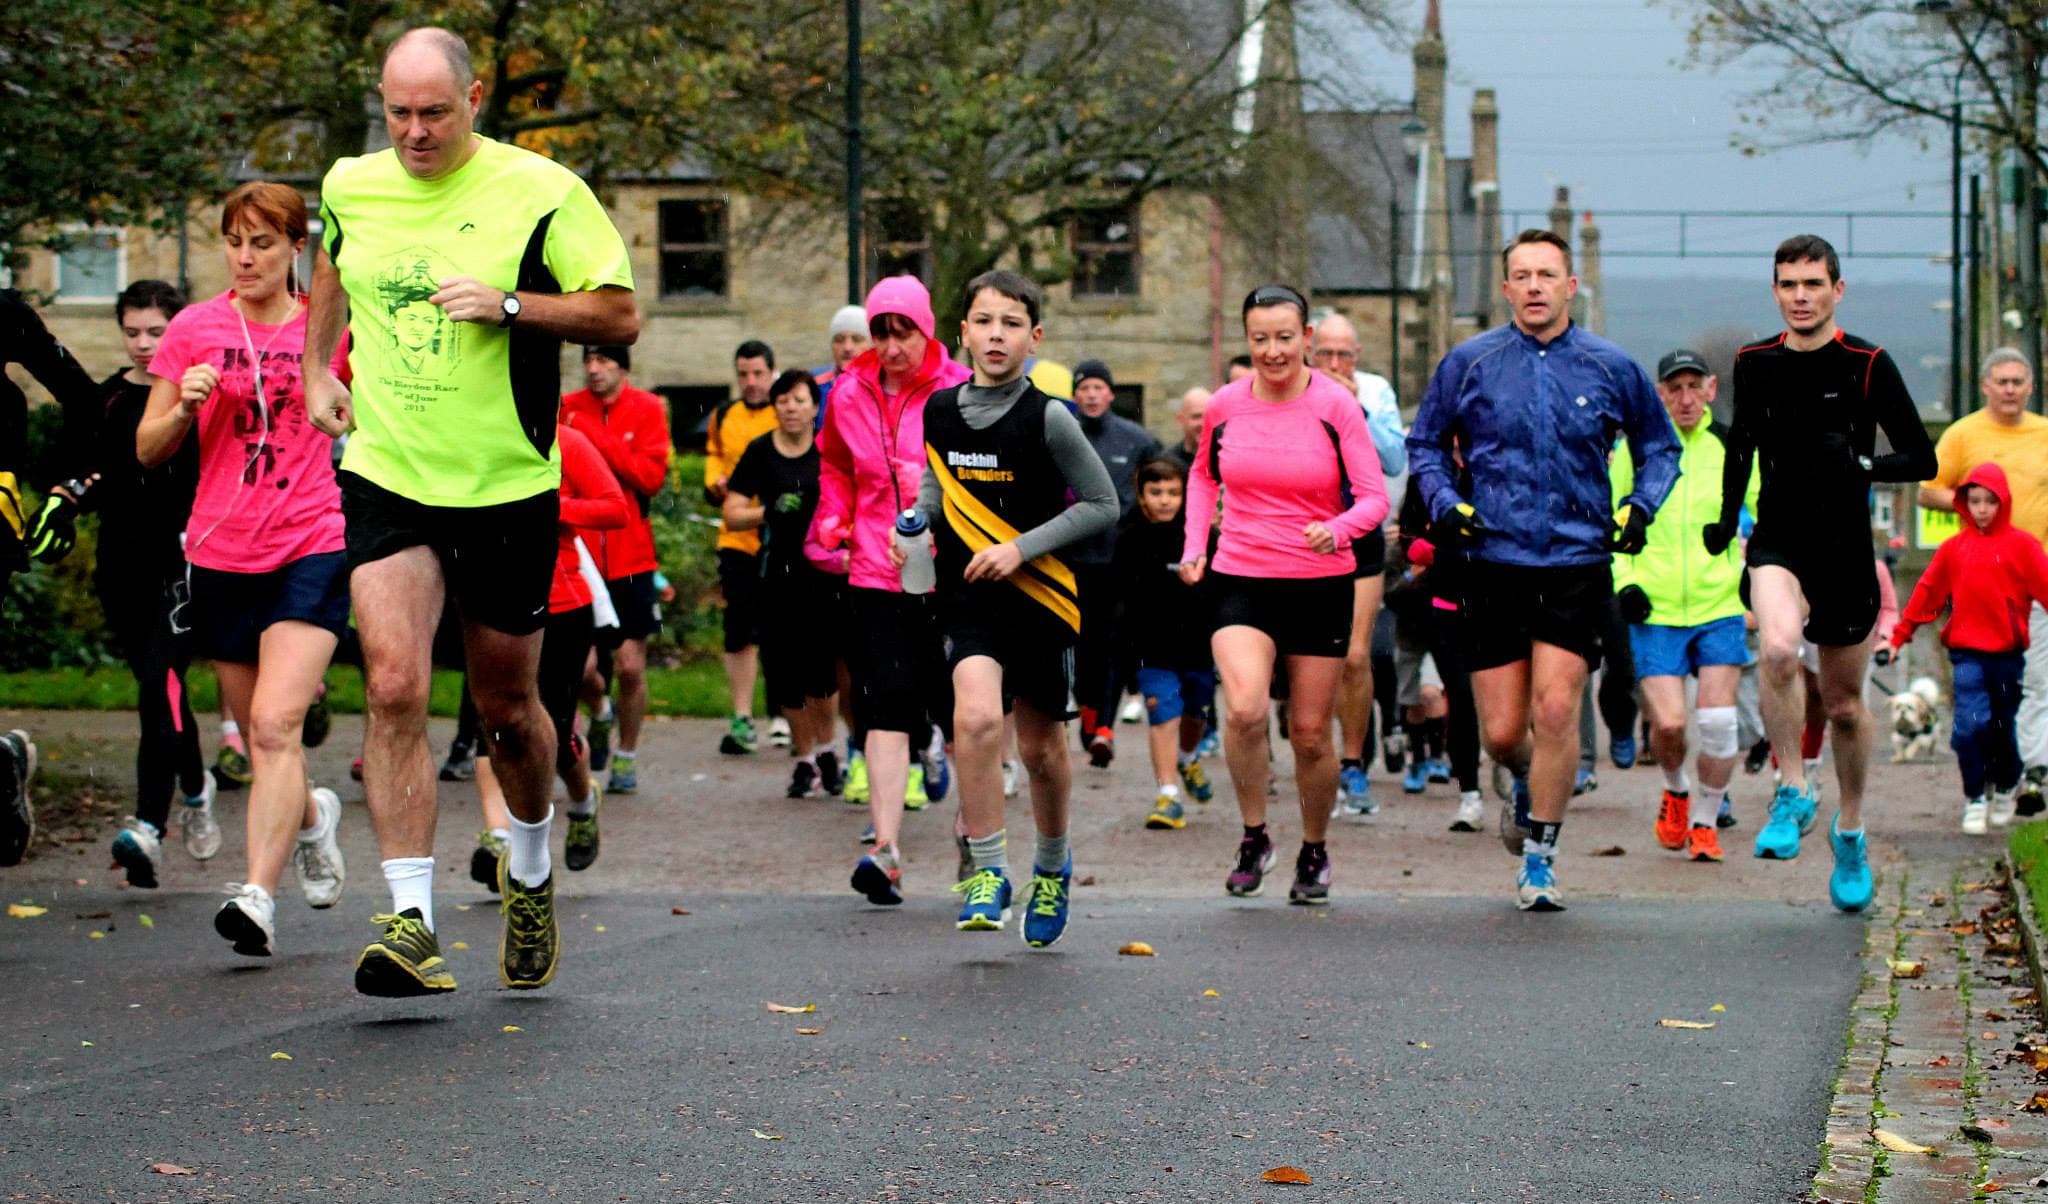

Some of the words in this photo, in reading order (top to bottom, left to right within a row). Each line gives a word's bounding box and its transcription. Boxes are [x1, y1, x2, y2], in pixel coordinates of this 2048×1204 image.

[379, 376, 392, 385] The
[434, 384, 459, 393] Race
[414, 393, 438, 402] June
[404, 403, 426, 413] 2013
[947, 451, 998, 468] Blackhill
[957, 467, 1015, 481] Bounders
